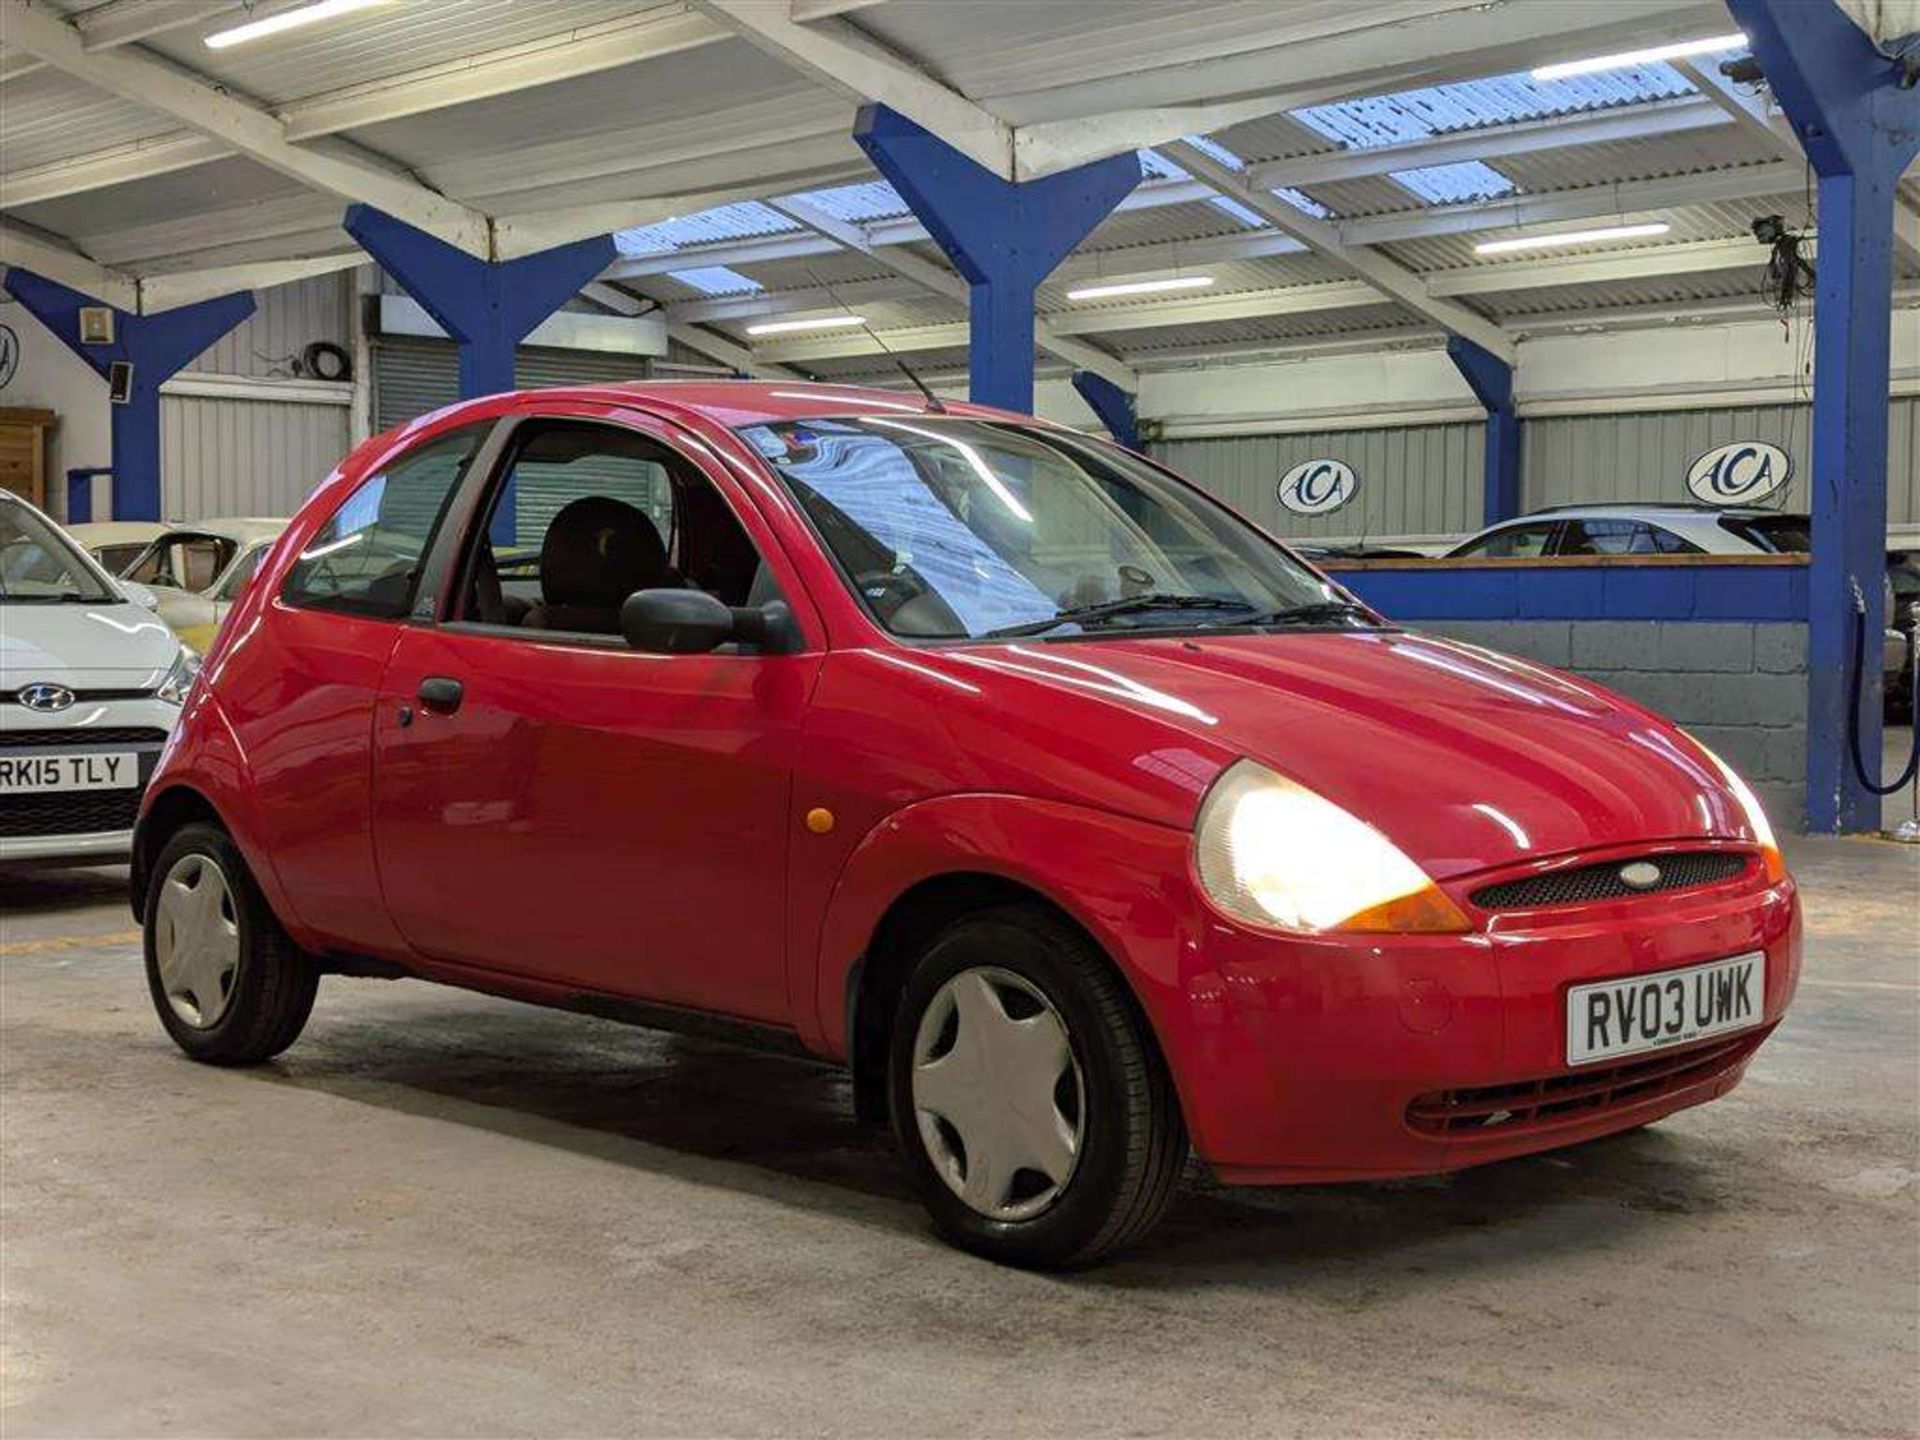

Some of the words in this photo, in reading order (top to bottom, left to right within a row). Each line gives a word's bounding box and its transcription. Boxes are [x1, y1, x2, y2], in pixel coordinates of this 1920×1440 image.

[1282, 464, 1344, 506] ACA
[1692, 447, 1773, 496] ACA
[68, 756, 121, 783] TLY
[1587, 977, 1685, 1051] RV03
[1694, 962, 1753, 1027] UWK
